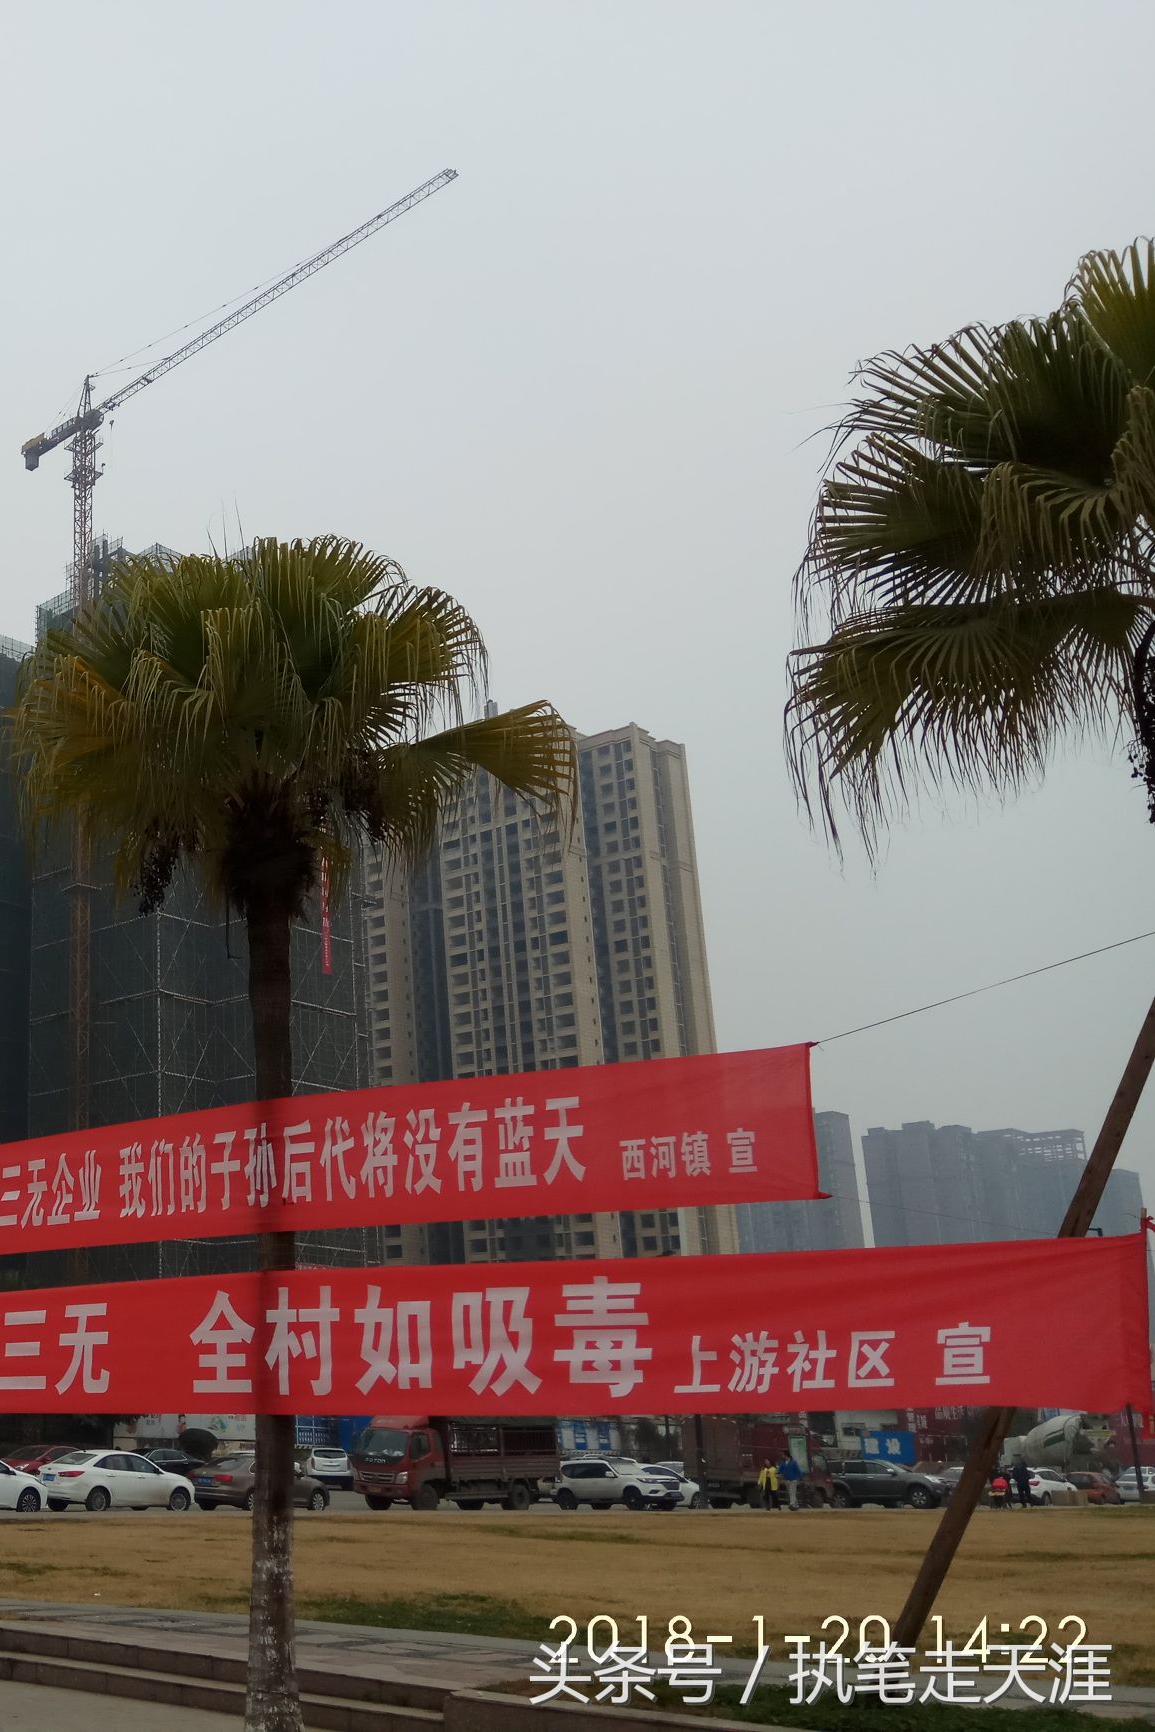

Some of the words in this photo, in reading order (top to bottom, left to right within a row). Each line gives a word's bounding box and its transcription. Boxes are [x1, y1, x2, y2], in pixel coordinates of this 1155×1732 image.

[119, 1096, 586, 1219] 我们的子孙后代将没有蓝天
[619, 1130, 711, 1179] 西河镇
[726, 1127, 757, 1173] 宣
[189, 1276, 653, 1398] 全村如吸毒
[673, 1330, 896, 1394] 上游社区
[935, 1321, 991, 1387] 宣
